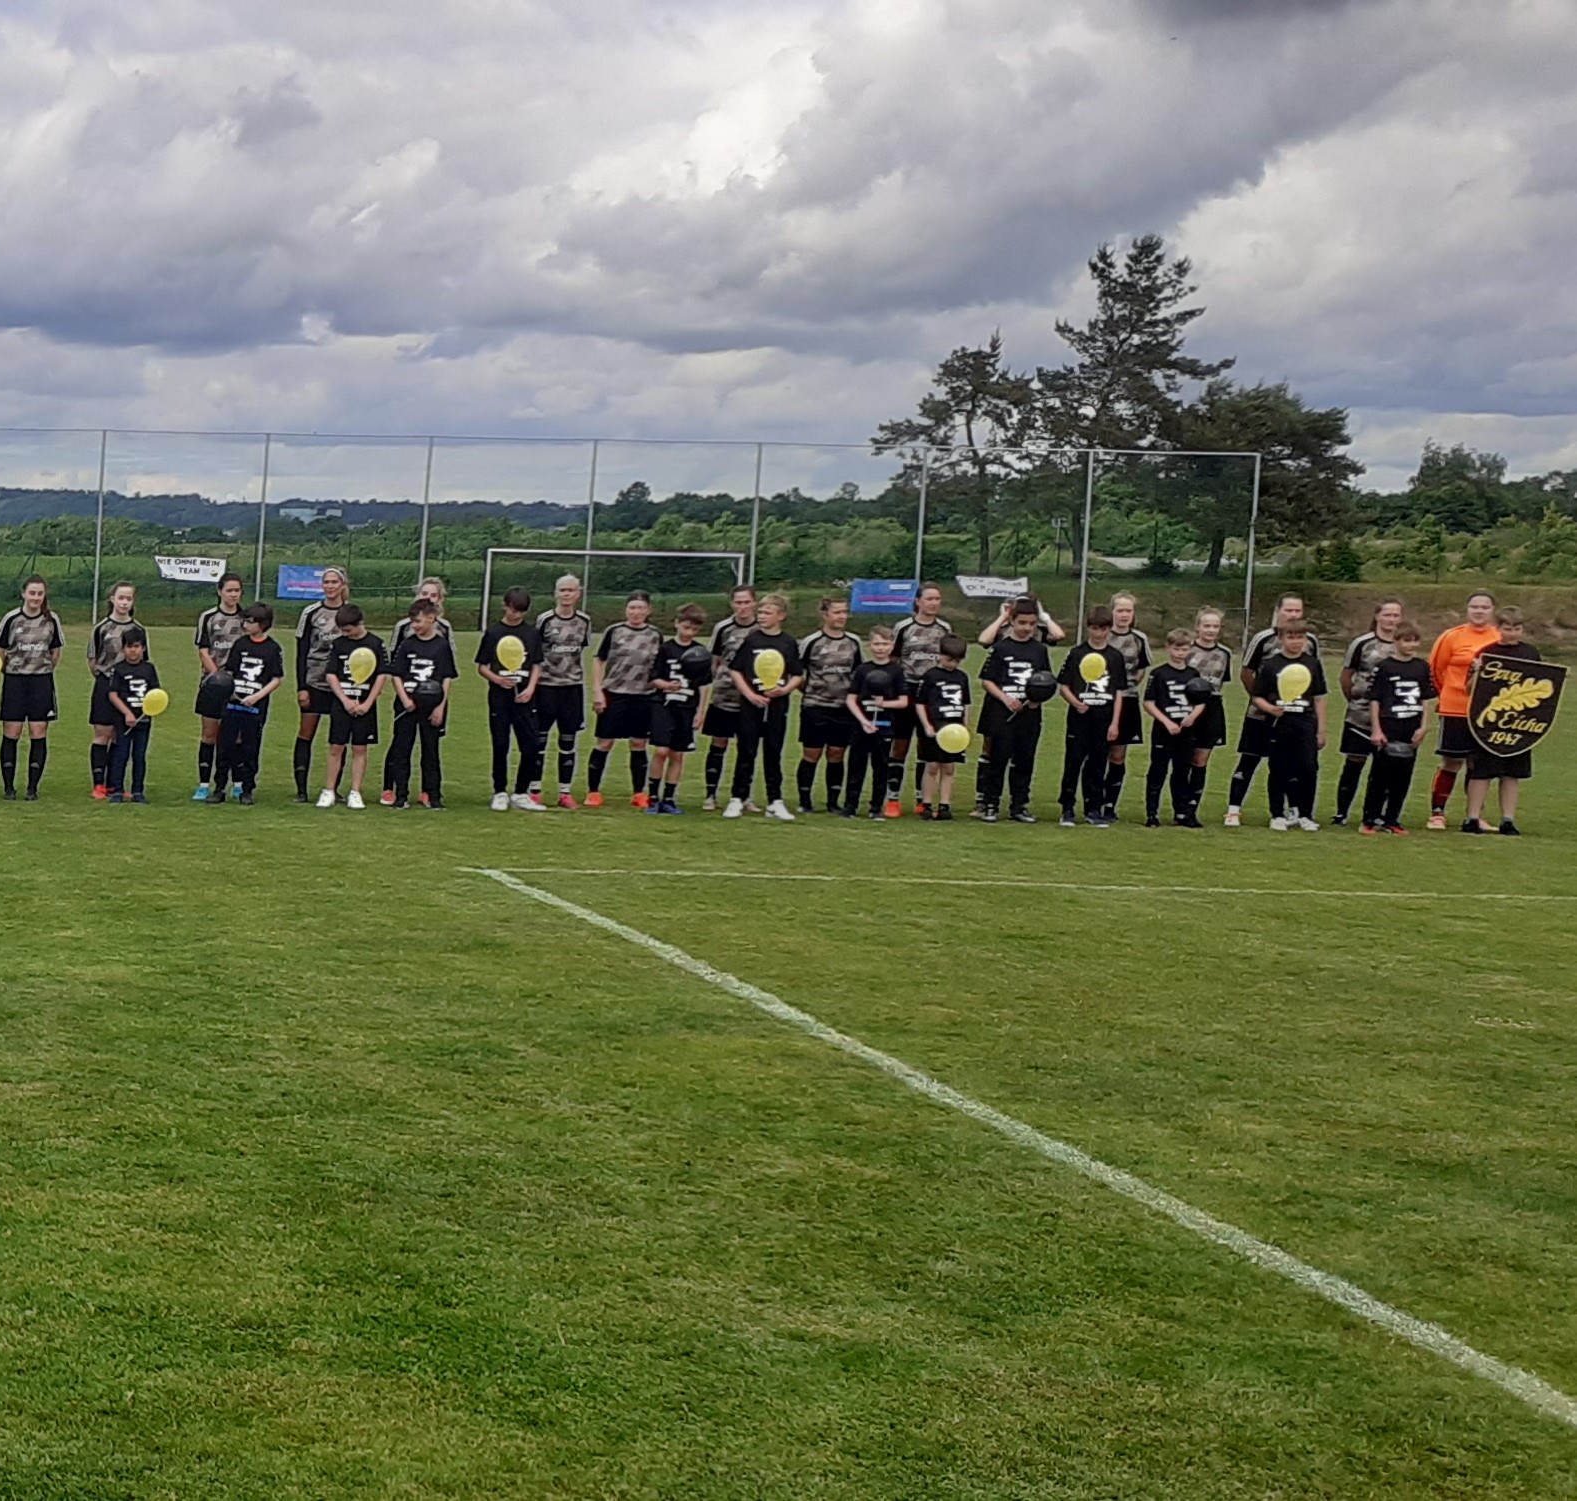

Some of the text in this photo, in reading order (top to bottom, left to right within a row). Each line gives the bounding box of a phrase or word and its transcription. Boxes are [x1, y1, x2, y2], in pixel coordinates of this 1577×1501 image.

[178, 567, 200, 575] TEAM
[1498, 711, 1548, 733] Eicha
[1488, 731, 1522, 745] 1947
